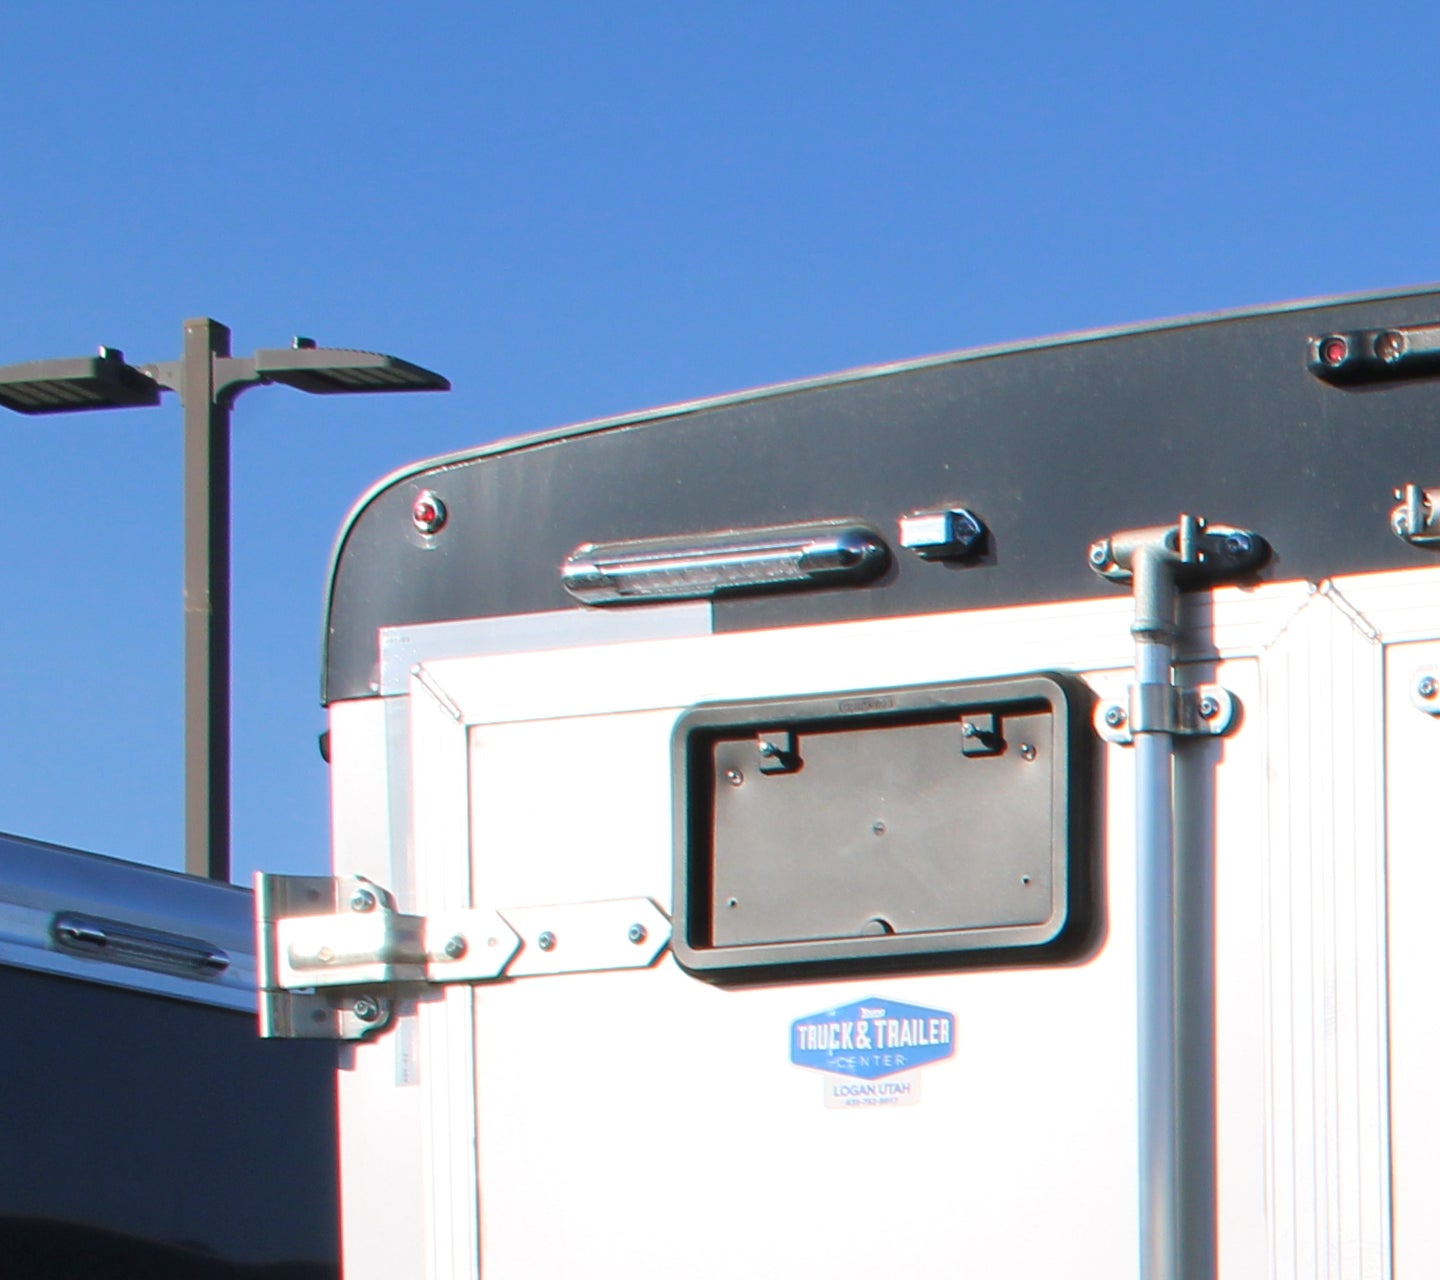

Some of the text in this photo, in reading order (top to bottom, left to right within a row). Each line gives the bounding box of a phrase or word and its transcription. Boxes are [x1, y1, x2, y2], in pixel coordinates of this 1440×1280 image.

[797, 1018, 951, 1051] TRUCK & TRAILER
[837, 1055, 906, 1069] CENTER
[833, 1082, 911, 1097] LOGAN UTAH
